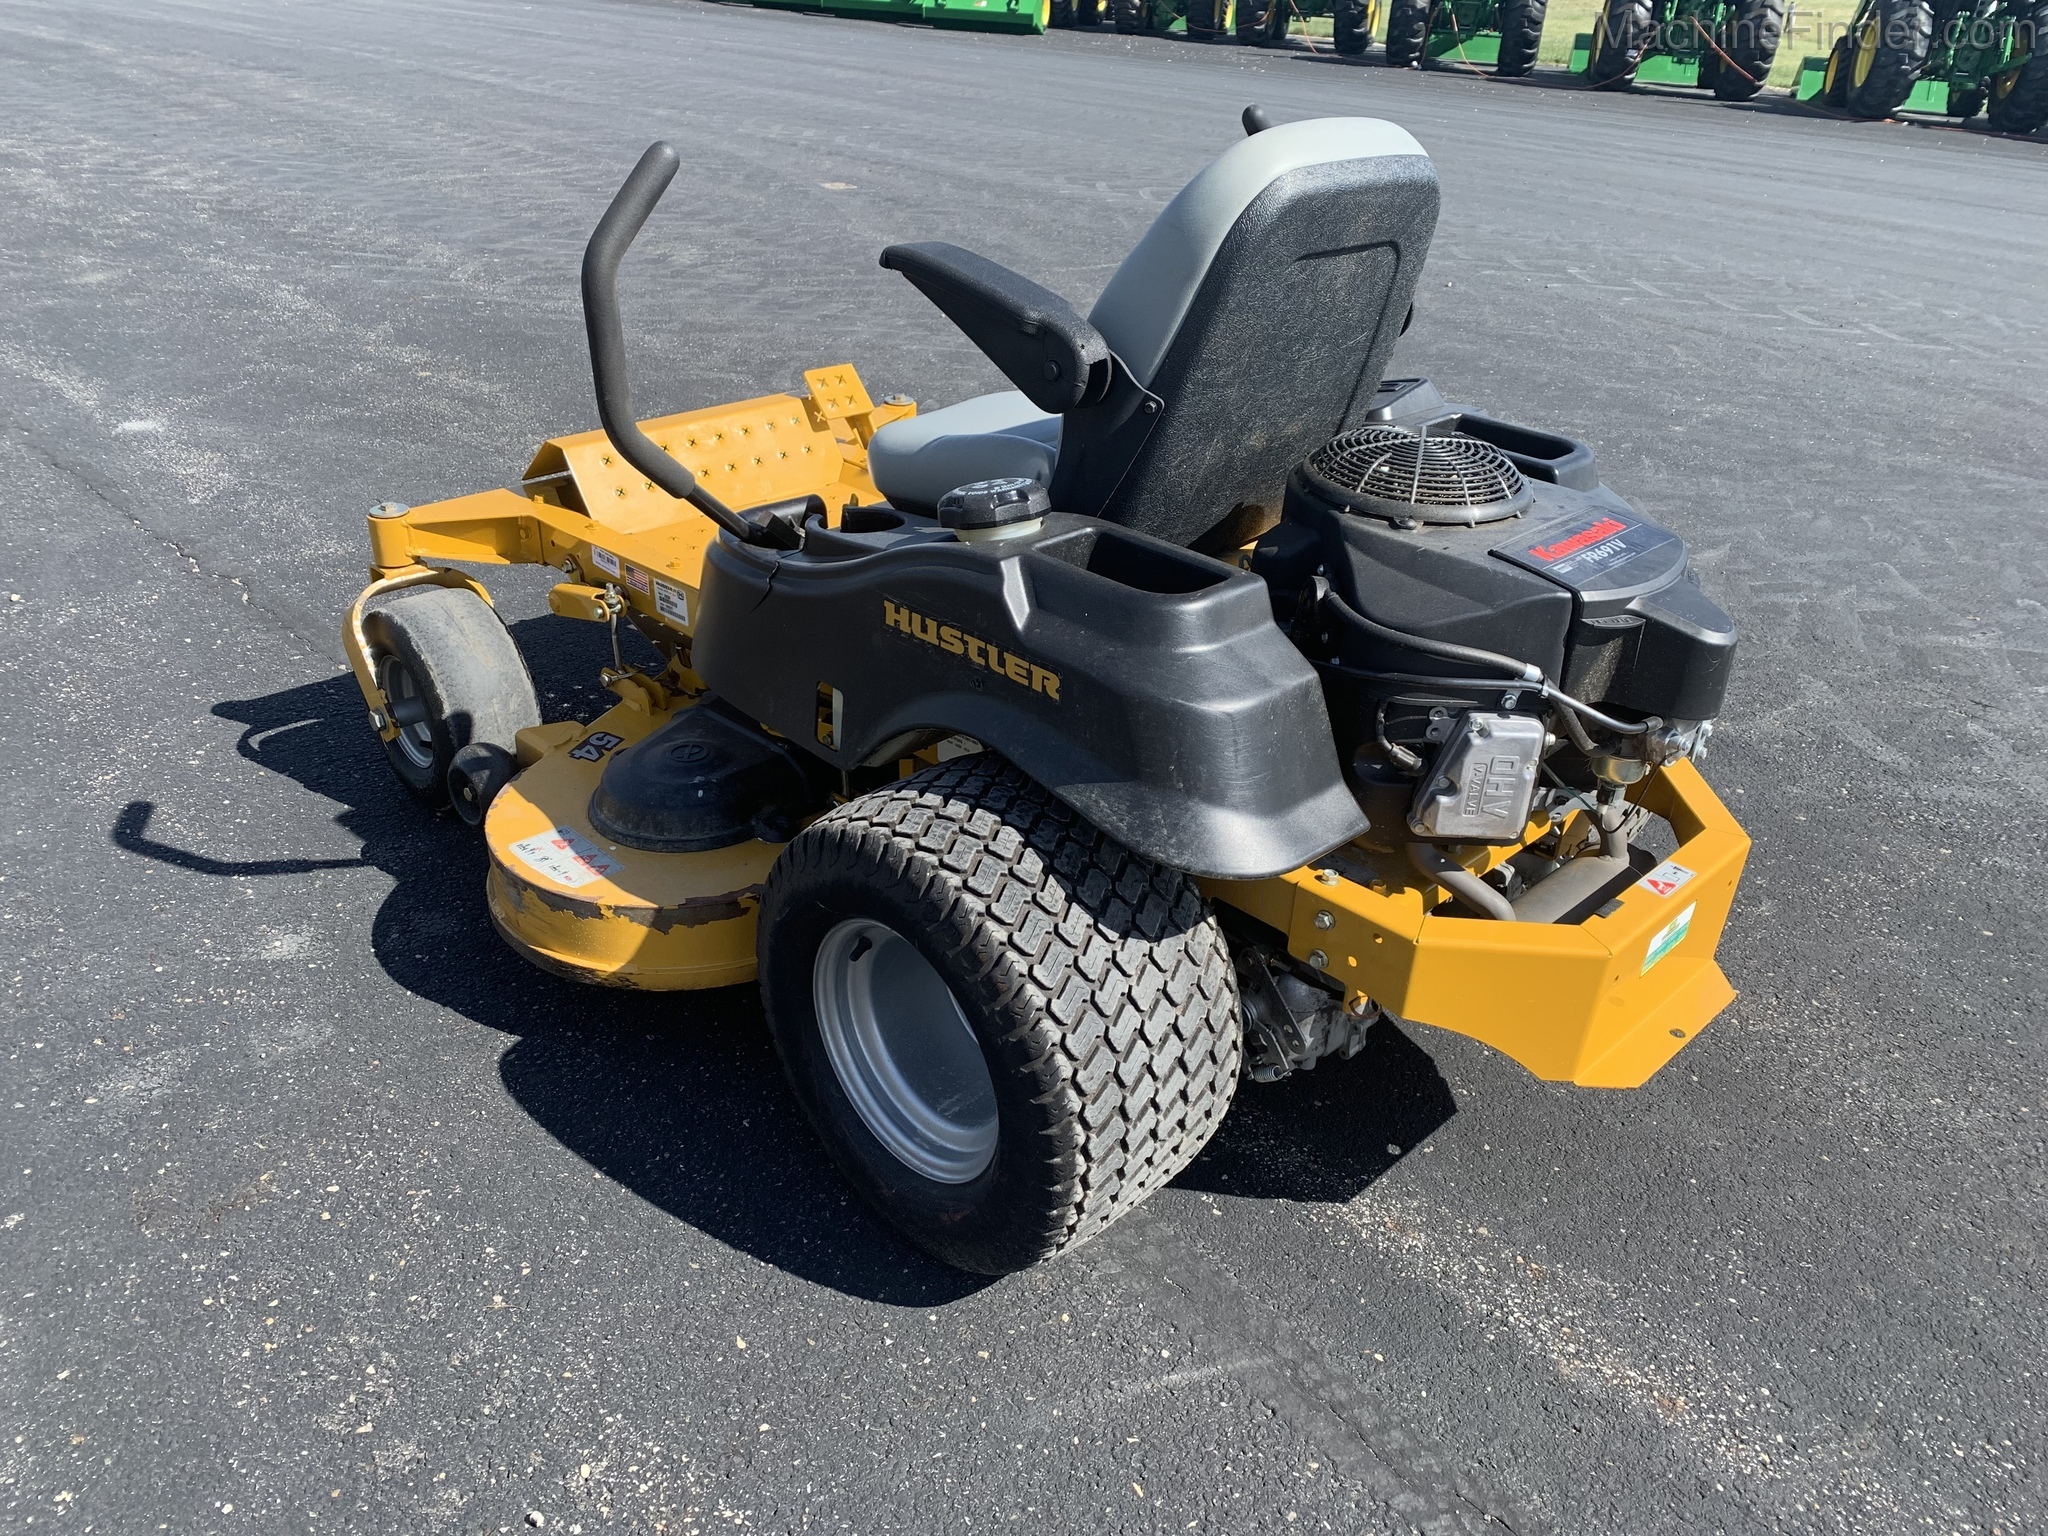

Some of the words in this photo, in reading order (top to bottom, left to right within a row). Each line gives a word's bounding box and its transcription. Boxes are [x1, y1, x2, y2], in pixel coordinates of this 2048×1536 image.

[1528, 517, 1627, 562] Kawasaki
[1581, 538, 1627, 564] FR691V
[883, 599, 1061, 700] HUSTLER
[572, 733, 620, 760] 54
[1464, 762, 1487, 816] V-VALVE
[1481, 755, 1520, 818] OHV
